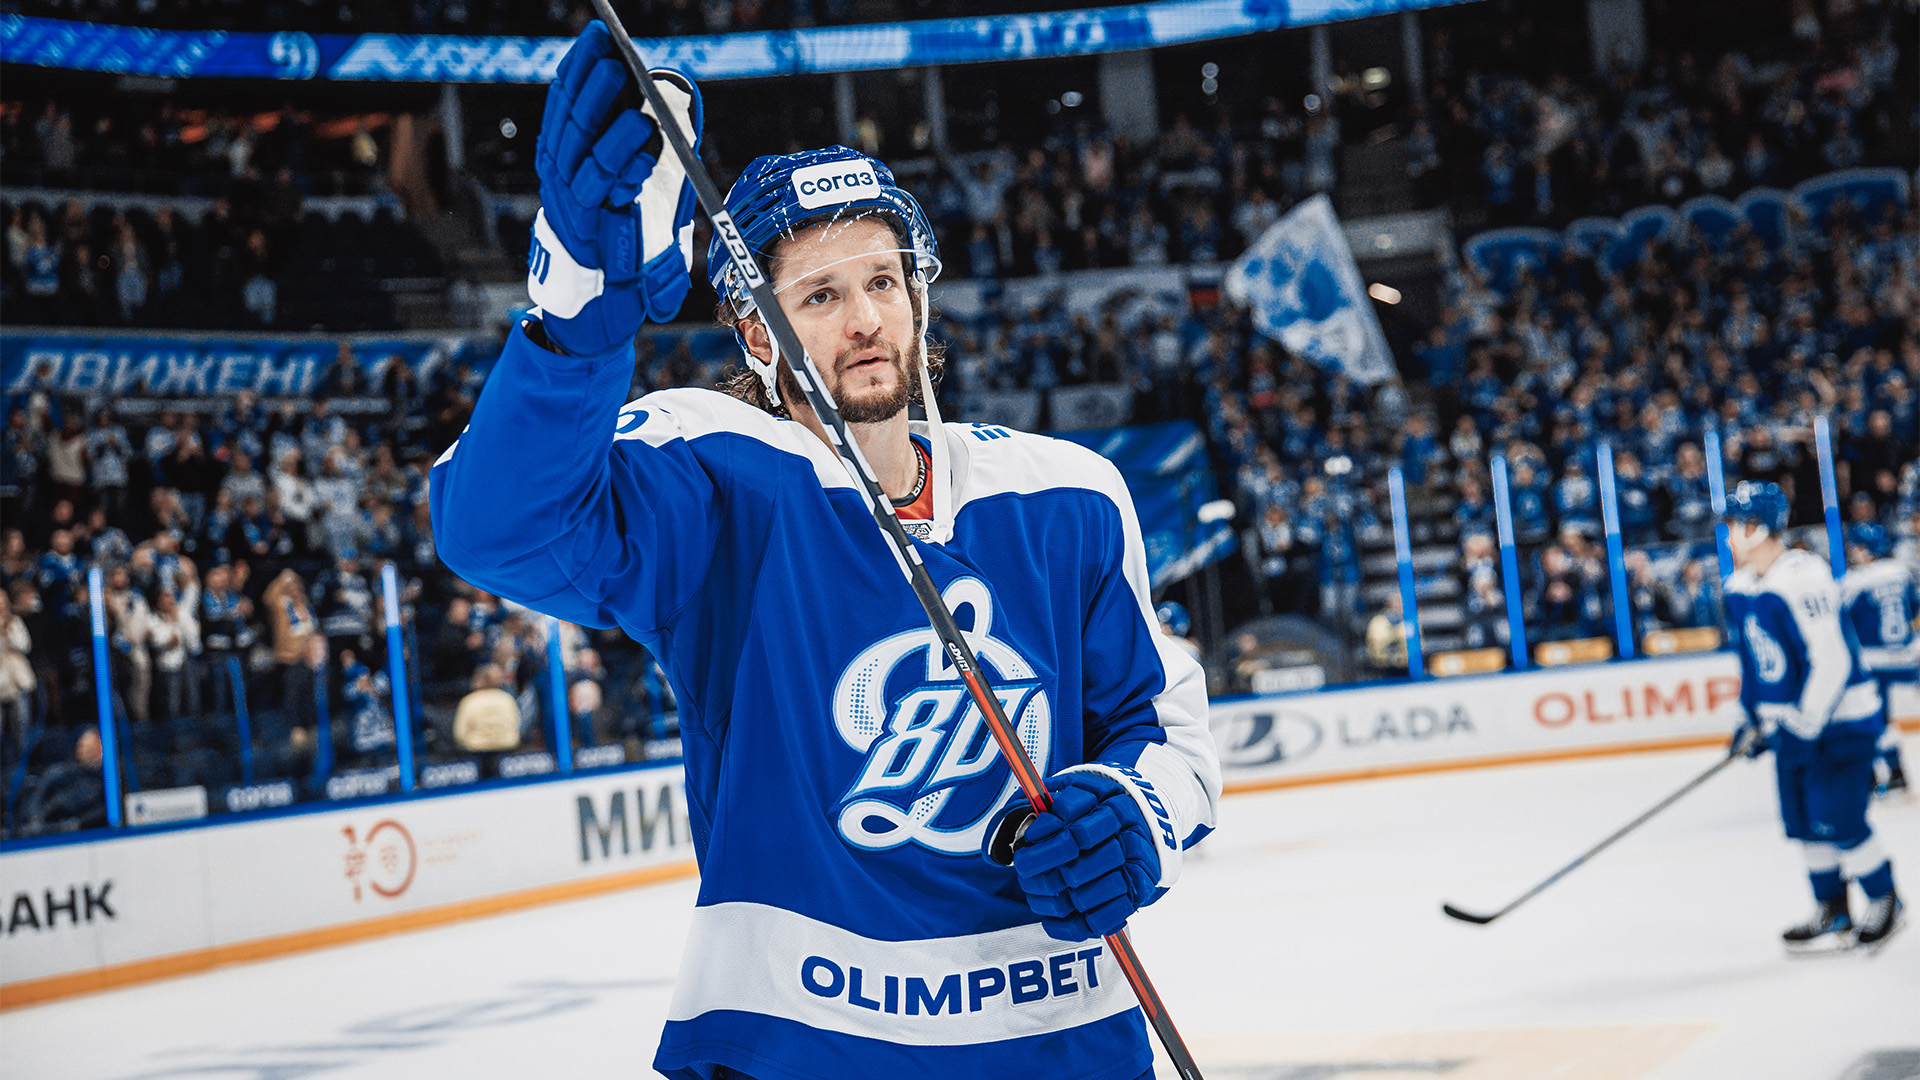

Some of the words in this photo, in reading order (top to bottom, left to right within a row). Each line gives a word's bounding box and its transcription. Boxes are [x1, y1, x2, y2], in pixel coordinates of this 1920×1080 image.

[800, 172, 874, 196] согаз
[718, 220, 759, 280] CCM
[1337, 703, 1476, 747] LADA
[0, 880, 114, 934] АНК
[800, 945, 1103, 1017] OLIMPBET
